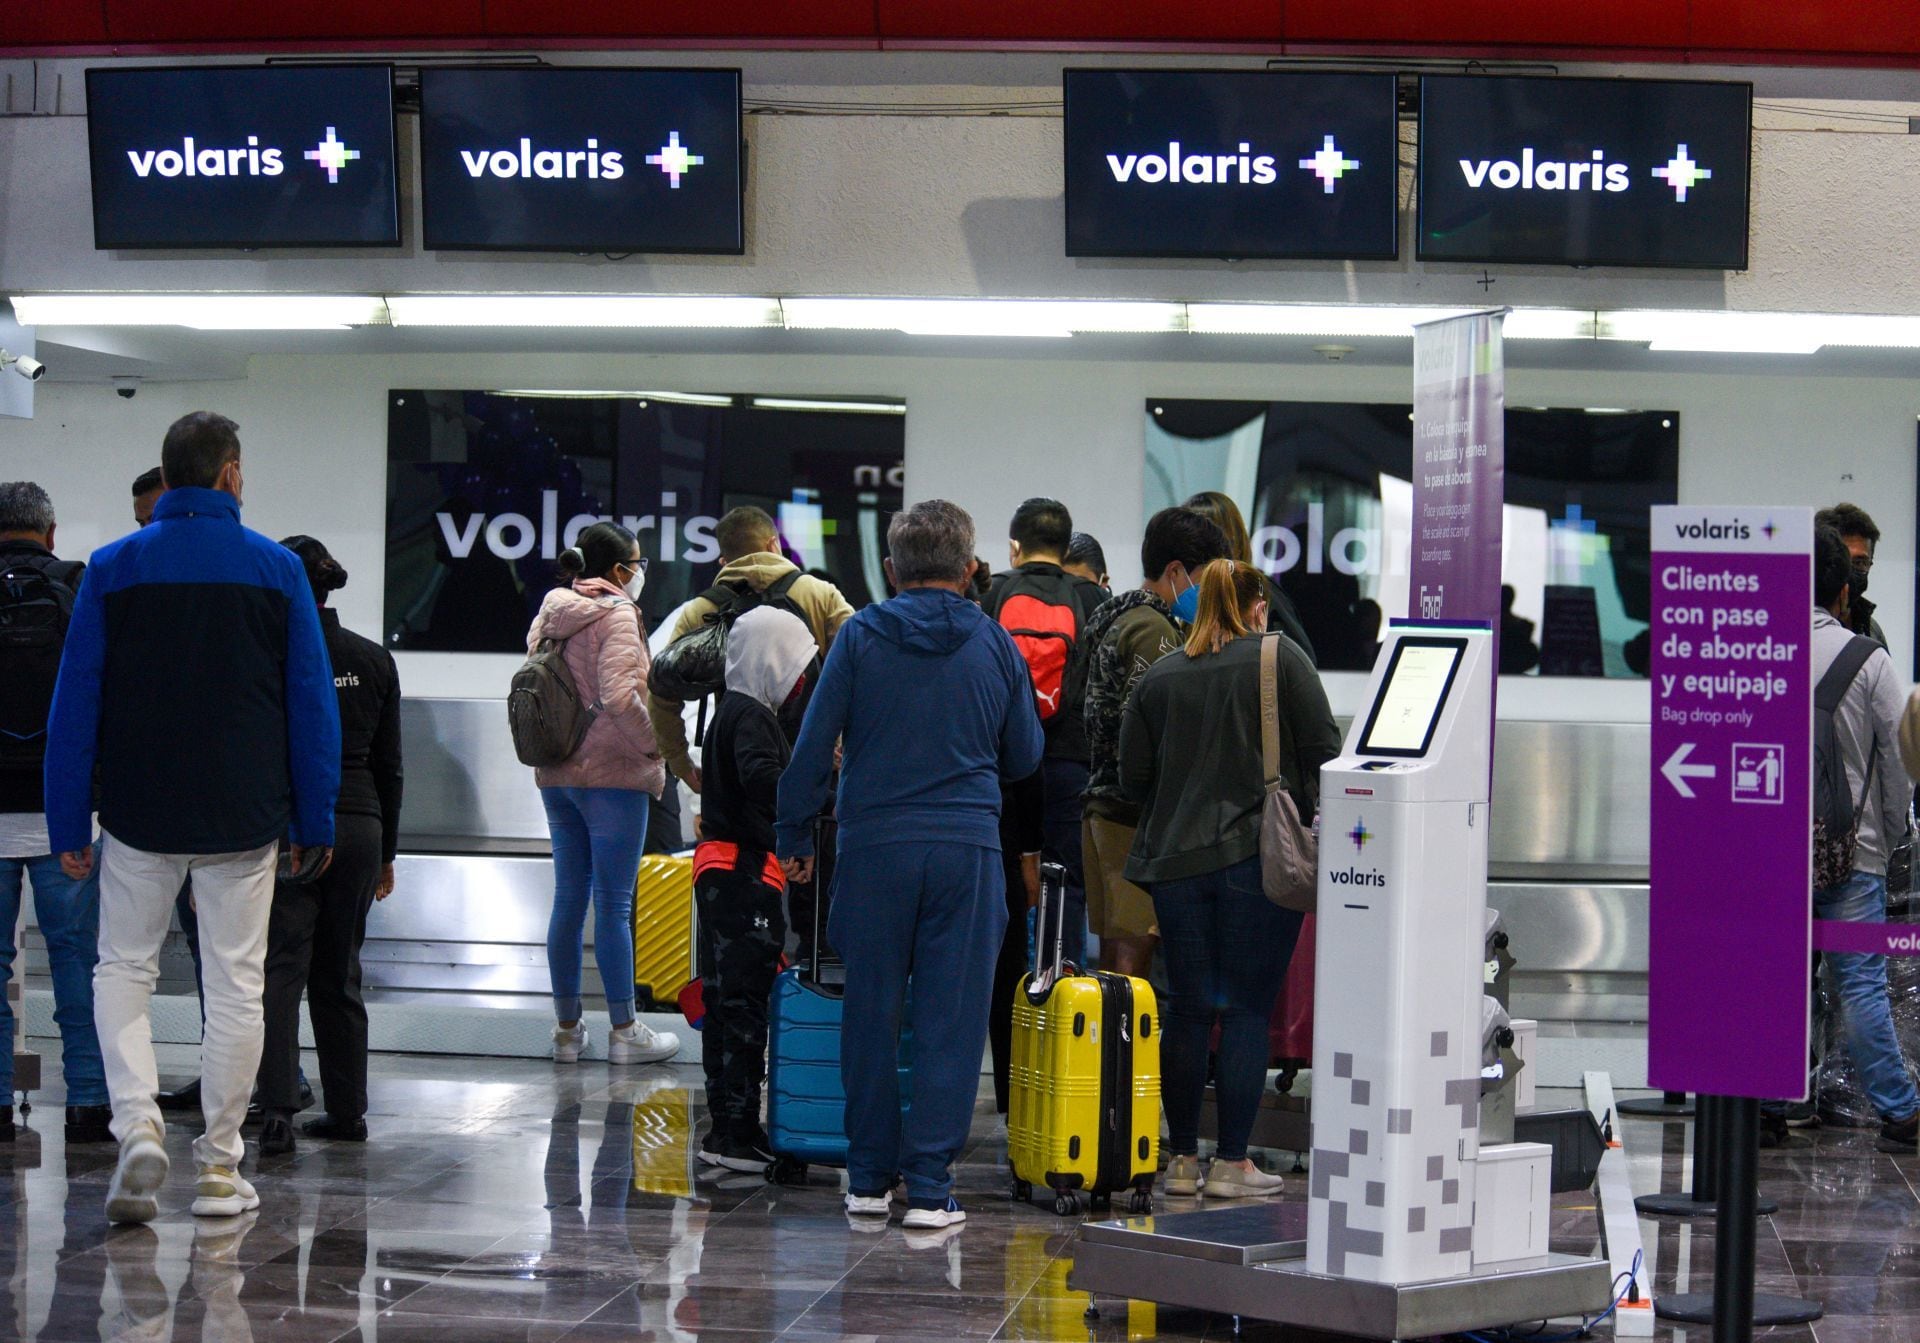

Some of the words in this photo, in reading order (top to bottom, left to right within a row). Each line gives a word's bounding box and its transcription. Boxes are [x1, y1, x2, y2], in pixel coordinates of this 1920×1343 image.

[127, 136, 284, 177] volaris
[461, 138, 624, 179] volaris
[1106, 142, 1276, 184] volaris
[1459, 148, 1629, 192] volaris
[1425, 450, 1432, 463] en
[1458, 447, 1464, 464] y
[1424, 473, 1430, 488] tu
[1676, 518, 1750, 540] volaris
[1661, 565, 1760, 592] Clientes
[1661, 606, 1704, 625] con
[1712, 607, 1769, 632] pase
[1661, 633, 1692, 658] de
[1700, 634, 1798, 662] abordar
[1661, 674, 1676, 698] y
[1683, 670, 1788, 702] equipaje
[1661, 706, 1687, 725] Bag
[1690, 707, 1722, 726] drop
[1725, 708, 1753, 728] only
[1329, 866, 1386, 887] volaris
